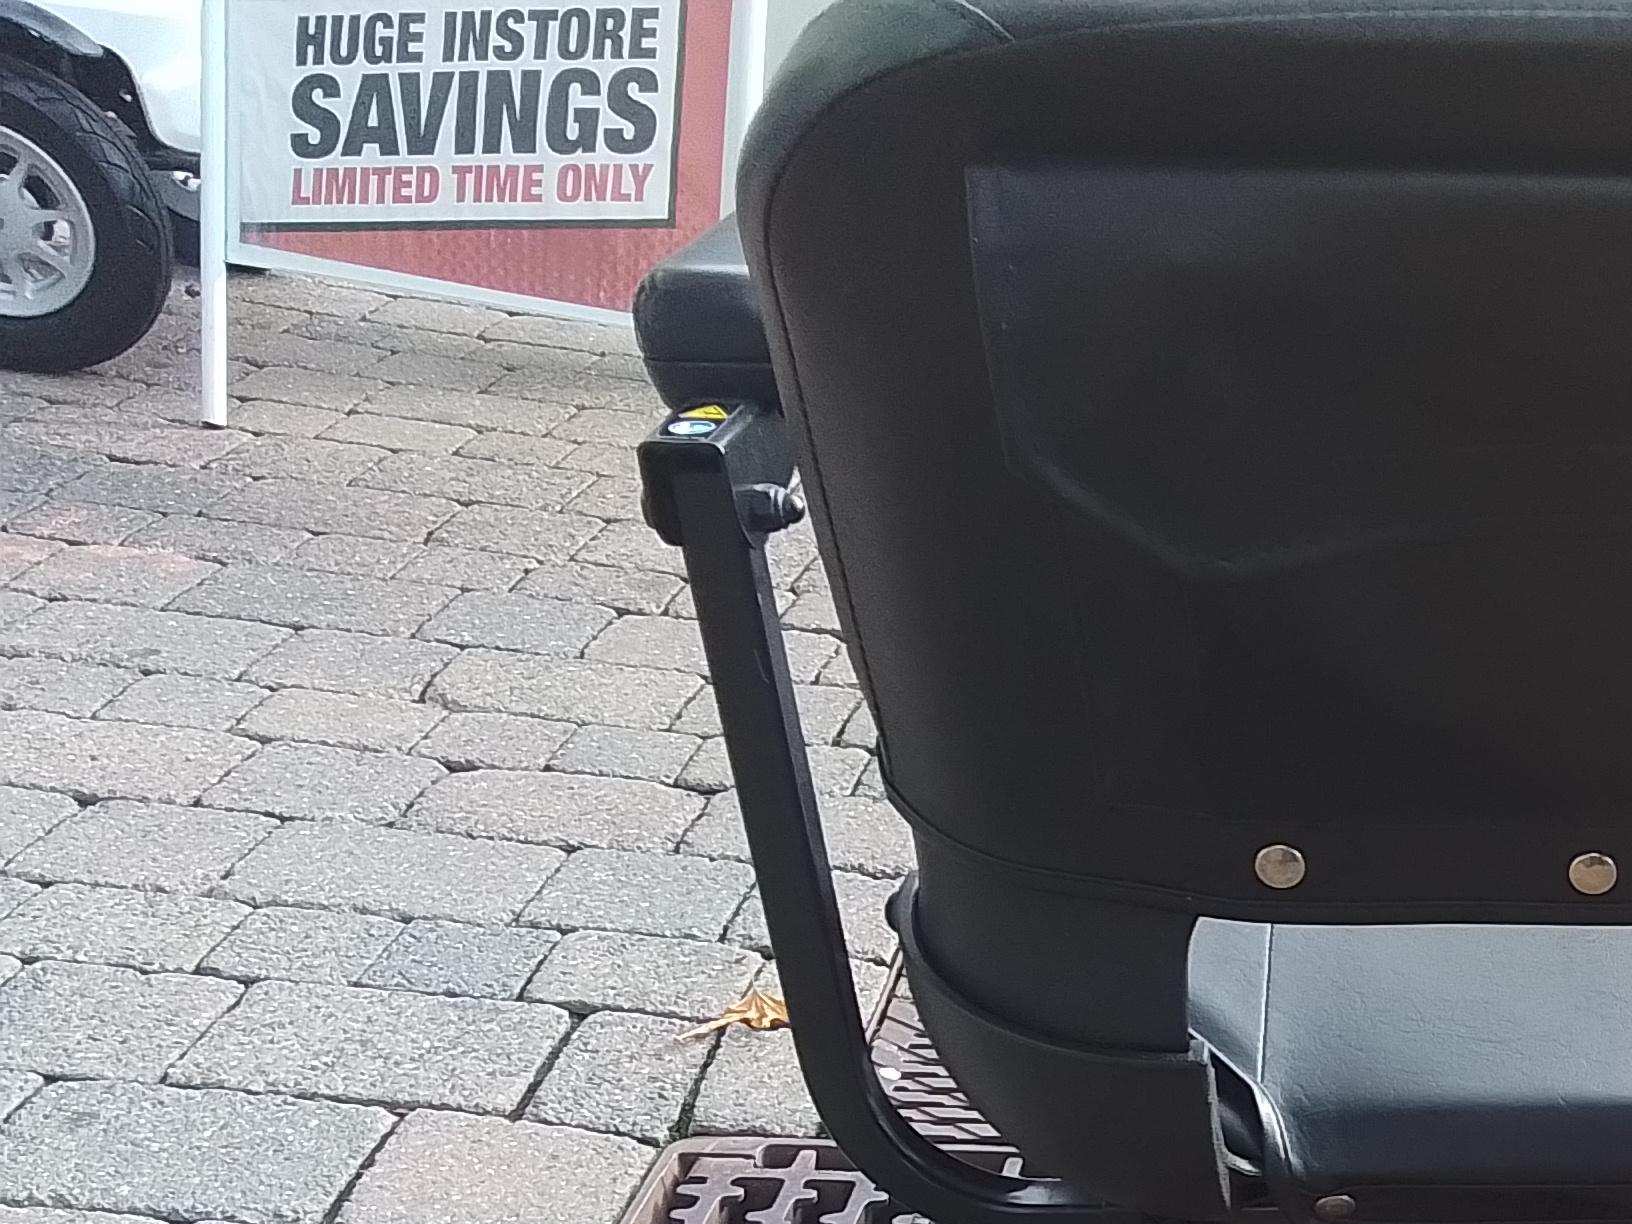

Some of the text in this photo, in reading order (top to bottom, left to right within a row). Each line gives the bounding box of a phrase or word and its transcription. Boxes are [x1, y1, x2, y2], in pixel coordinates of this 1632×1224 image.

[295, 8, 659, 66] HUGE INSTORE
[290, 67, 659, 158] SAVINGS
[291, 163, 654, 206] LIMITED TIME ONLY
